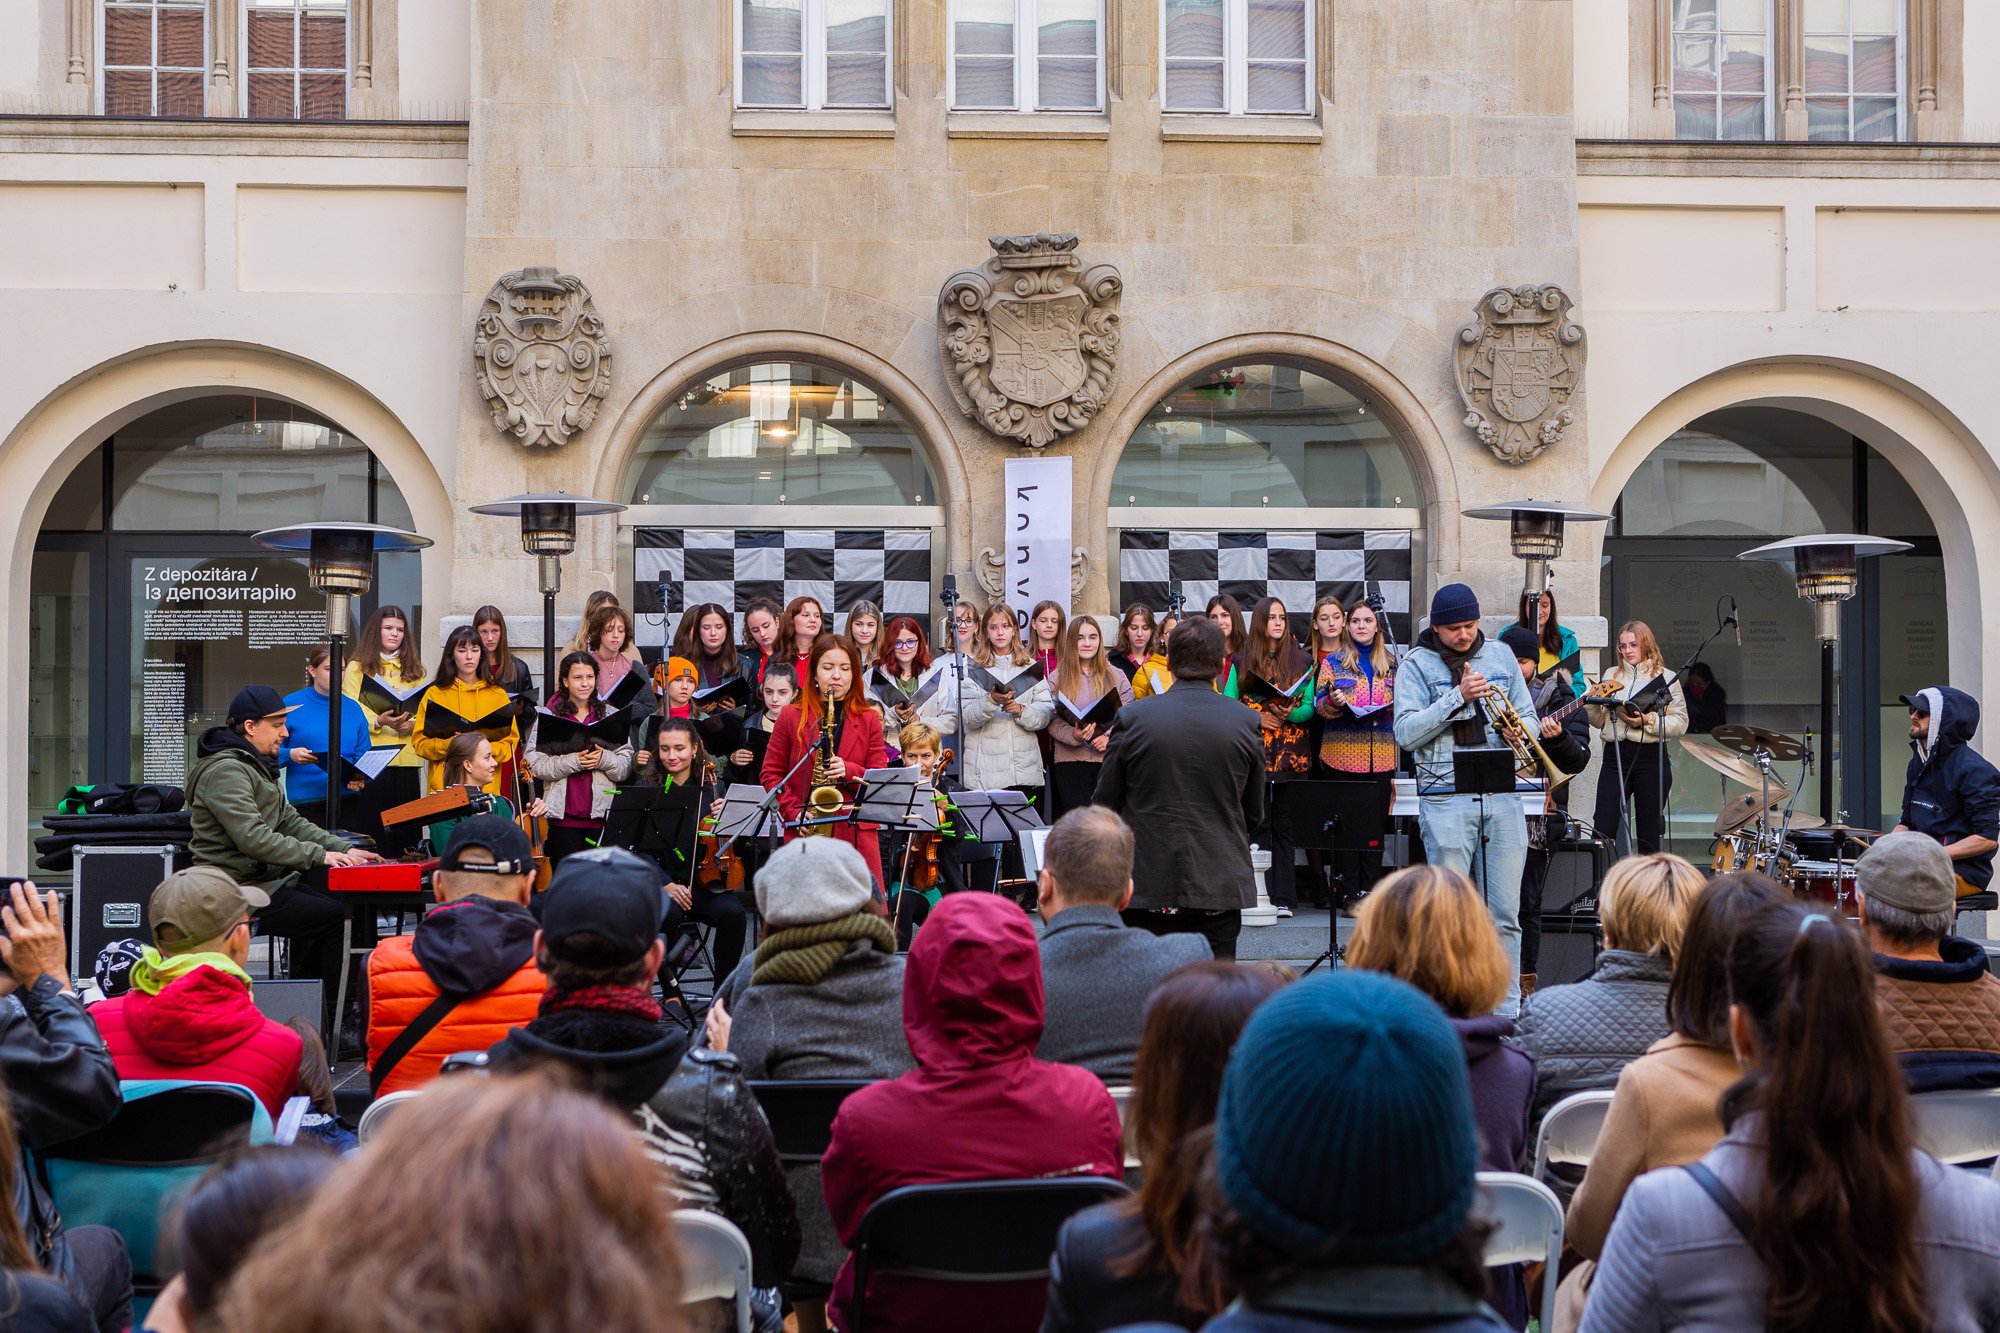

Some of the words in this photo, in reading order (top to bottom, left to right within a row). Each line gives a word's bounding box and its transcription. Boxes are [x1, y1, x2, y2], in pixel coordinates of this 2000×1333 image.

[144, 567, 156, 581] Z
[160, 566, 247, 584] depozitára
[145, 584, 162, 600] Із
[166, 584, 297, 603] депозитарію
